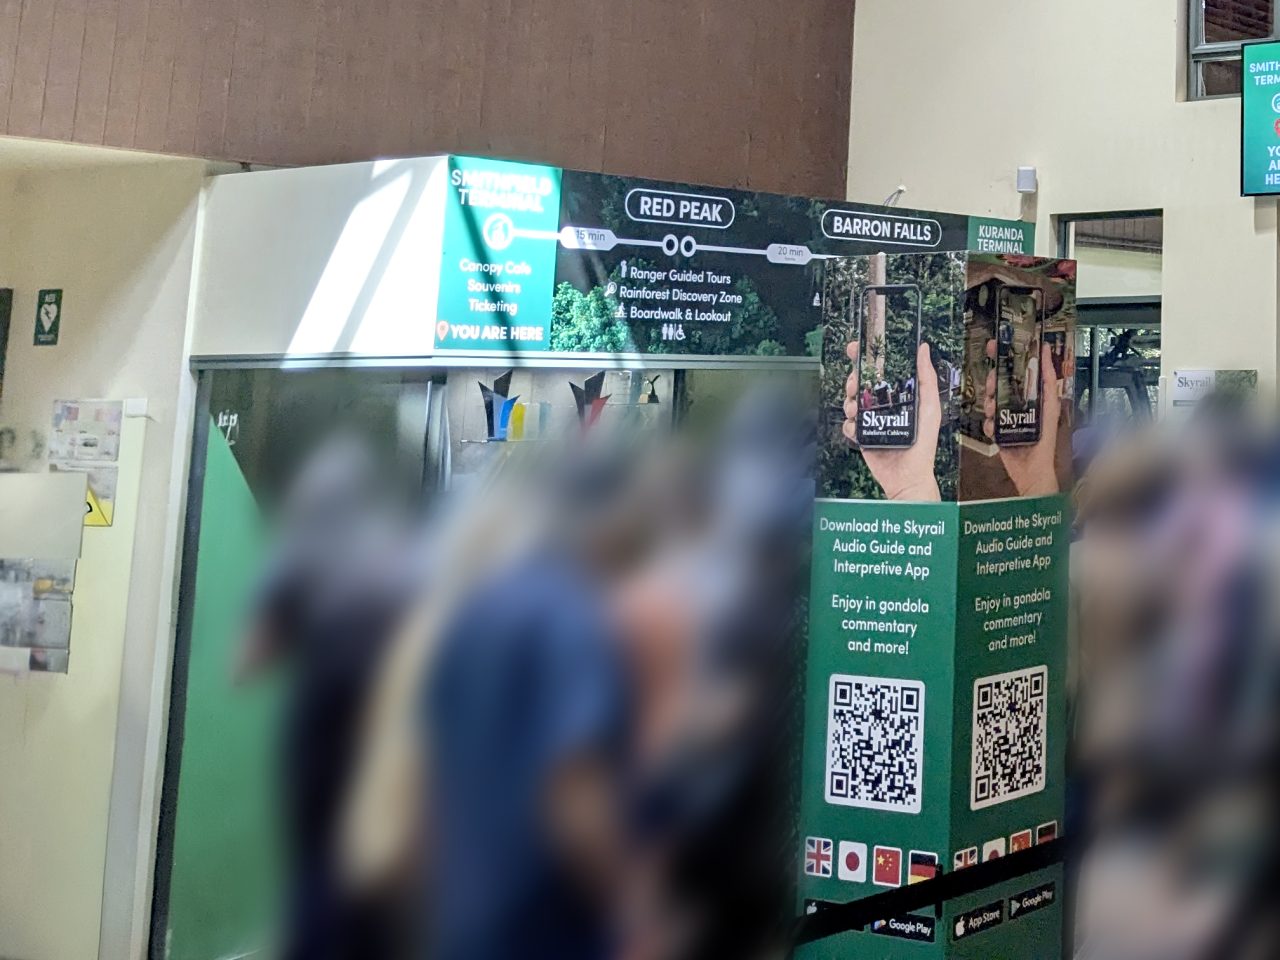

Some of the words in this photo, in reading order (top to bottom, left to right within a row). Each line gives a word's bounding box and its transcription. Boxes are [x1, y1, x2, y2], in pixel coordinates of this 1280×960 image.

[640, 196, 675, 218] RED
[679, 200, 722, 223] PEAK
[588, 231, 605, 241] min
[833, 216, 891, 238] BARRON
[894, 223, 931, 241] FALLS
[978, 225, 1024, 240] KURANDA
[778, 247, 787, 255] 20
[790, 248, 803, 256] min
[977, 239, 1024, 254] TERMINAL
[459, 258, 503, 276] Canopy
[630, 267, 666, 282] Ranger
[669, 269, 703, 283] Guided
[706, 272, 731, 284] Tours
[468, 279, 521, 293] Souvenirs
[620, 286, 670, 301] Rainforest
[672, 290, 717, 304] Discovery
[719, 293, 742, 304] Zone
[468, 298, 518, 316] Ticketing
[630, 306, 682, 320] Boardwalk
[685, 309, 692, 320] &
[695, 309, 731, 321] Lookout
[451, 325, 480, 339] YOU
[482, 326, 507, 339] ARE
[511, 327, 543, 340] HERE
[863, 411, 908, 430] Skyrail
[1000, 409, 1035, 428] Skyrail
[820, 518, 878, 534] Download
[882, 519, 900, 534] the
[904, 521, 945, 537] Skyrail
[965, 516, 1013, 535] Download
[1015, 513, 1029, 528] the
[1032, 511, 1062, 531] Skyrail
[833, 539, 866, 553] Audio
[870, 541, 905, 555] Guide
[908, 542, 932, 556] and
[976, 539, 1003, 555] Audio
[1006, 536, 1032, 551] Guide
[1035, 533, 1053, 547] and
[834, 559, 902, 577] Interpretive
[904, 565, 929, 580] App
[977, 558, 1031, 576] Interpretive
[1033, 555, 1051, 570] App
[832, 595, 863, 612] Enjoy
[866, 596, 876, 610] in
[879, 598, 929, 614] gondola
[975, 597, 1000, 612] Enjoy
[1003, 594, 1011, 607] in
[1013, 589, 1050, 607] gondola
[842, 617, 917, 637] commentary
[983, 612, 1042, 632] commentary
[848, 639, 871, 652] and
[874, 641, 909, 655] more!
[989, 638, 1007, 651] and
[1010, 631, 1036, 648] more!
[1022, 896, 1041, 908] Google
[889, 920, 915, 933] Google
[917, 923, 931, 936] Play
[969, 915, 981, 928] App
[983, 910, 999, 923] Store
